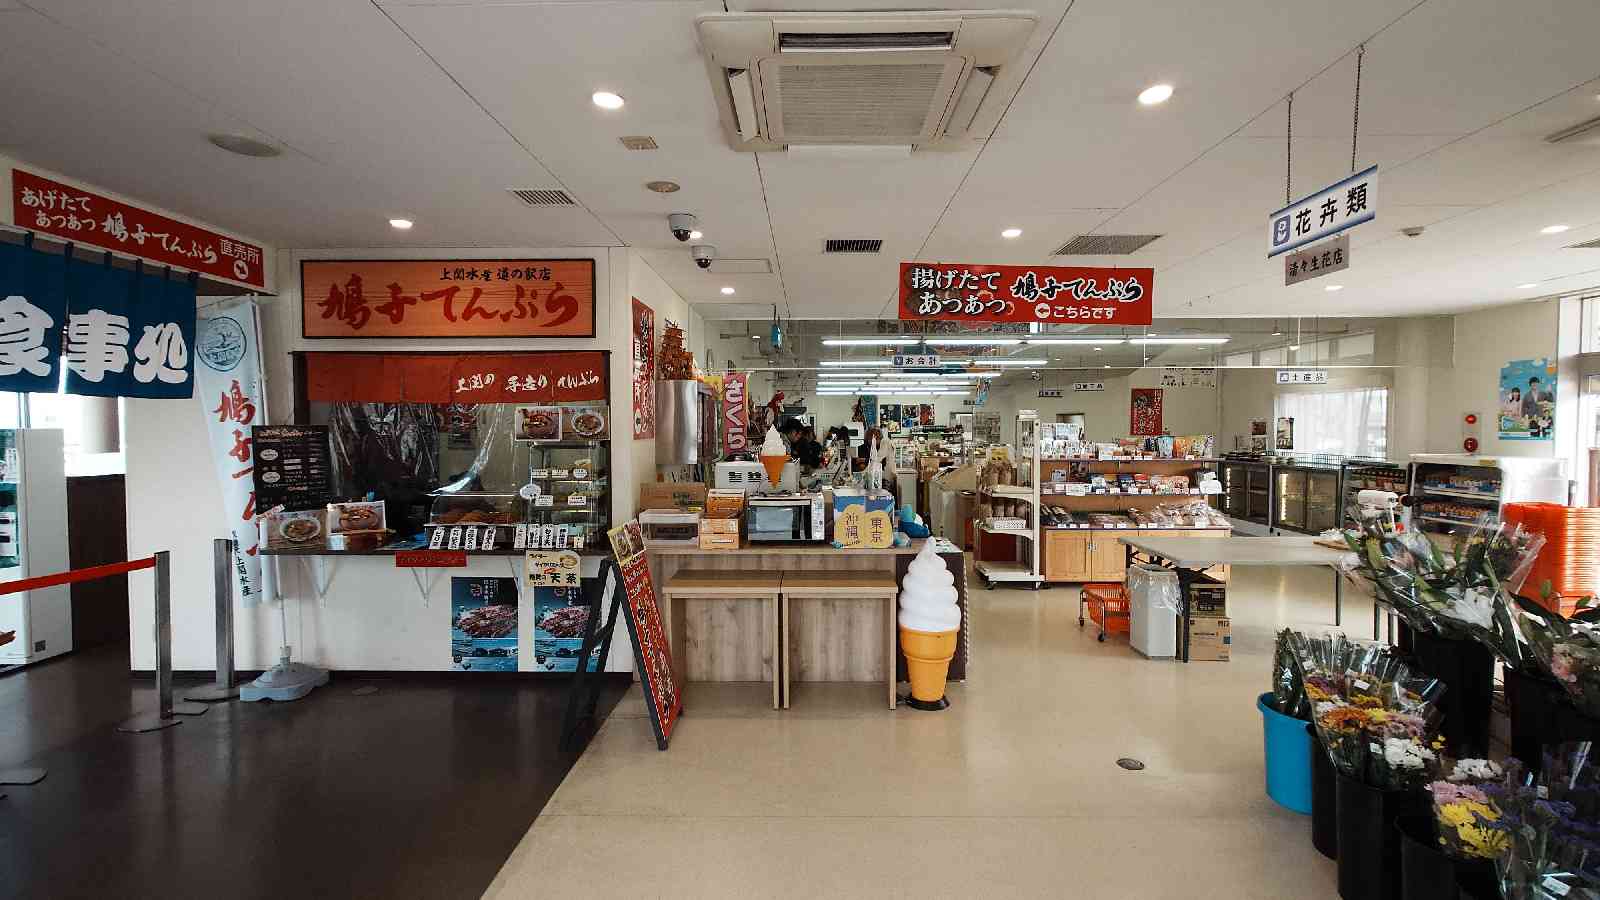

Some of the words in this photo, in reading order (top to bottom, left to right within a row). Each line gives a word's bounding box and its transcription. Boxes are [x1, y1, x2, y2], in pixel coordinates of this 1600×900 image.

[20, 186, 92, 213] あげたて
[1295, 182, 1368, 237] 花卉類
[35, 209, 97, 231] あつあつ
[103, 211, 219, 265] 鳩子てんぷら
[220, 238, 260, 265] 直売所
[911, 267, 1001, 290] 揚げたて
[1009, 271, 1145, 302] 鳩子てんぷら
[317, 273, 579, 330] 鳩子てんぷら
[919, 292, 1007, 315] あつあつ
[1053, 305, 1117, 319] こちらです
[905, 356, 936, 366] お会計
[870, 517, 883, 543] 東京
